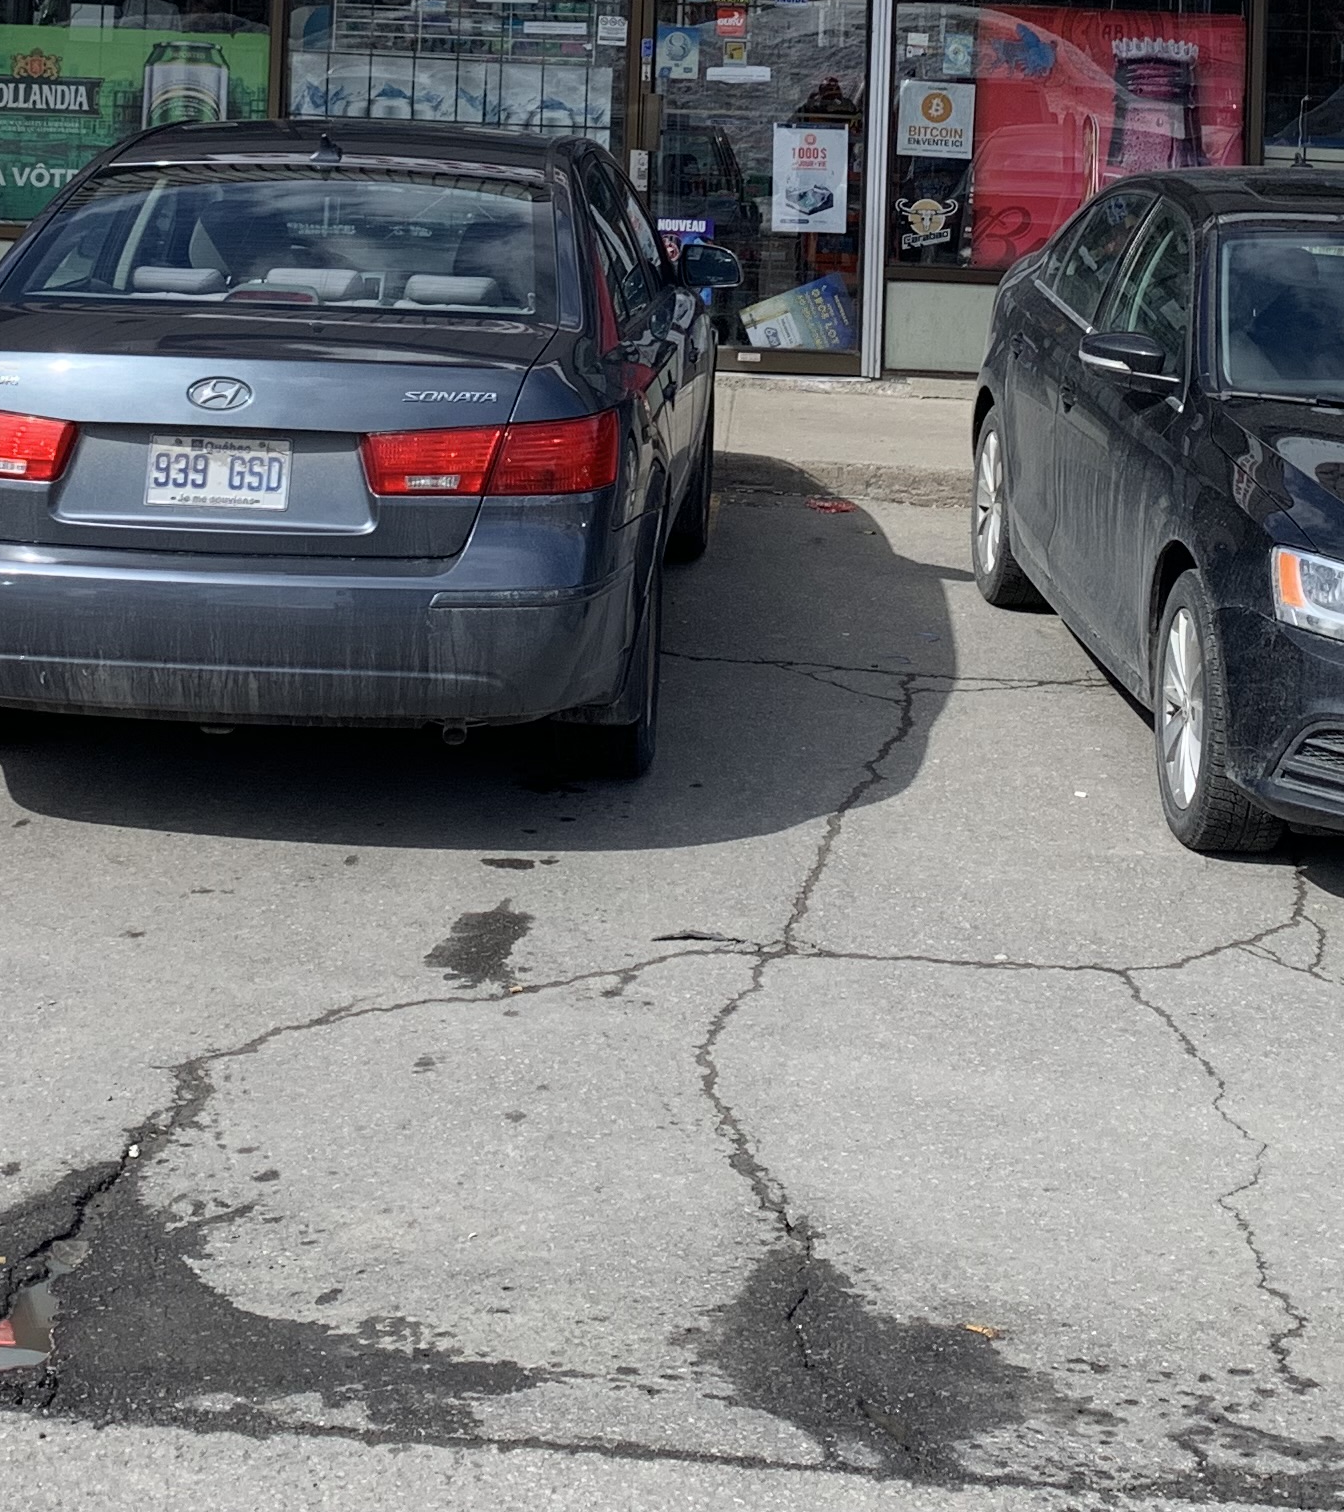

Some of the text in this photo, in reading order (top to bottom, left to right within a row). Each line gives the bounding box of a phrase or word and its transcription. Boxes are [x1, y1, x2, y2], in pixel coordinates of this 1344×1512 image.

[908, 125, 963, 139] BITCOIN
[908, 137, 963, 148] EN VENTE ICI
[12, 163, 79, 188] VÔT
[657, 219, 706, 233] NOUVEAU
[402, 390, 498, 404] SONATA
[205, 441, 251, 454] Québec
[154, 452, 283, 492] 939 GSD
[209, 496, 255, 505] souviens
